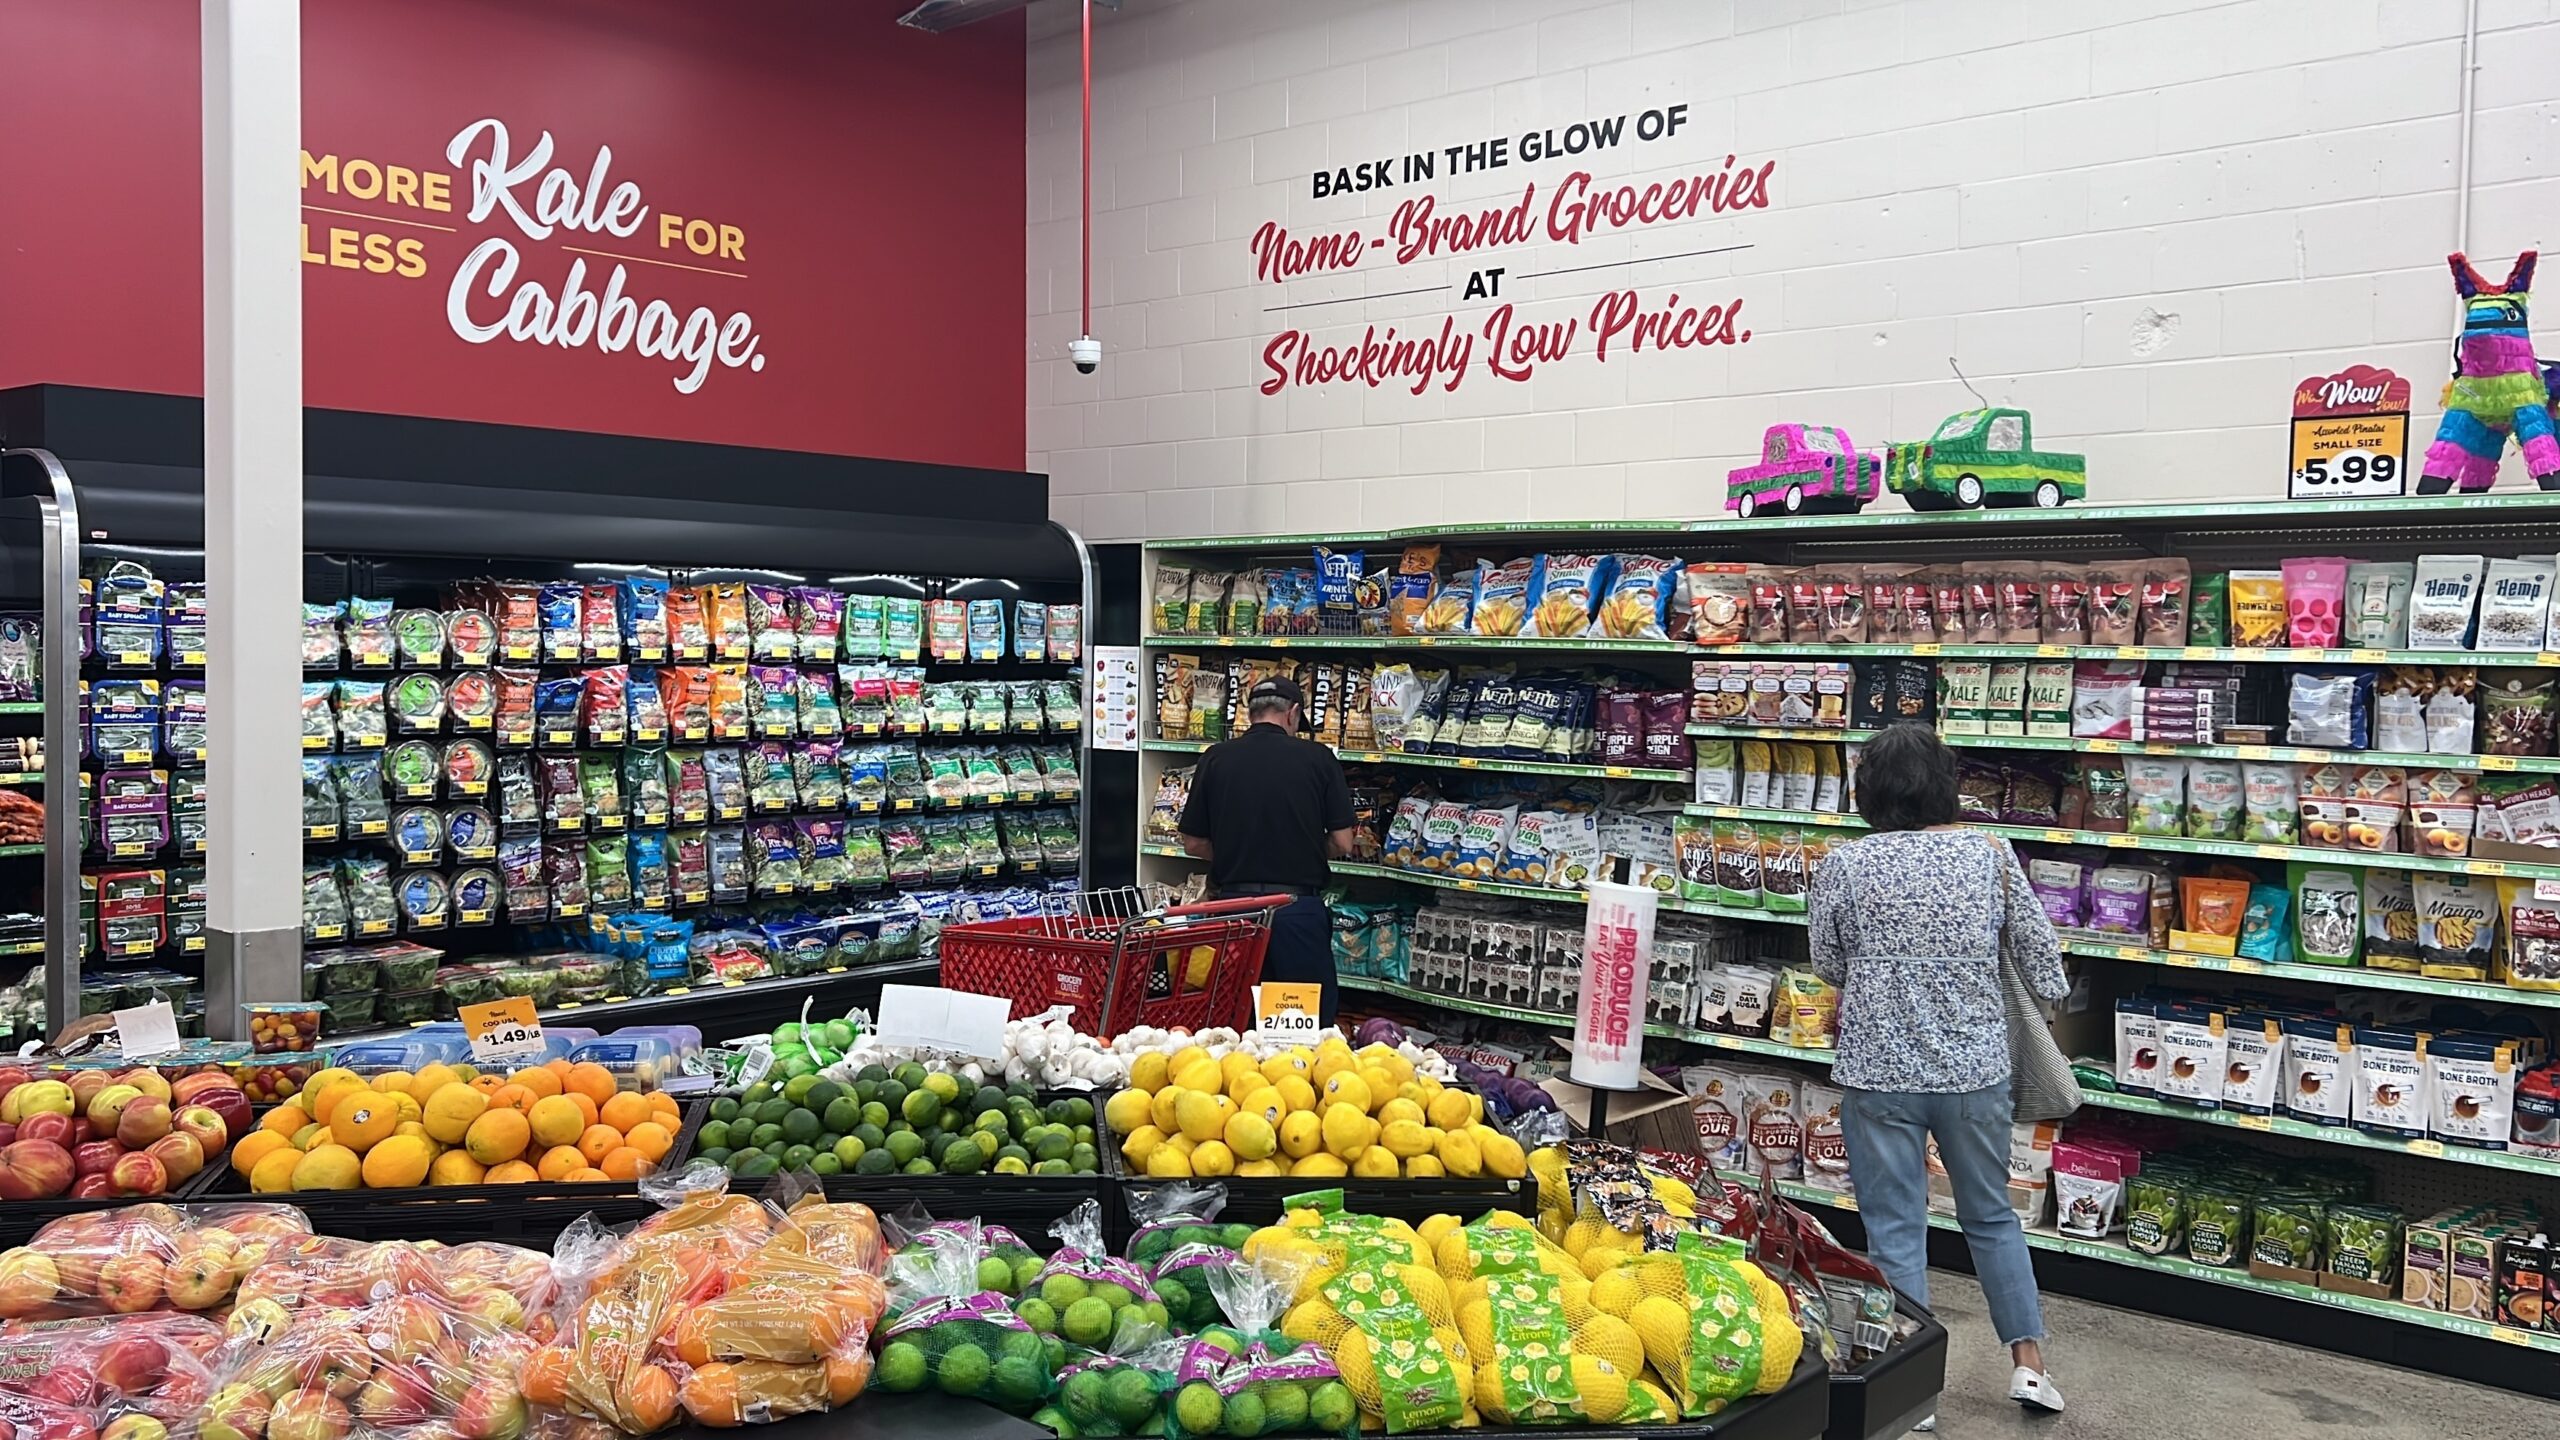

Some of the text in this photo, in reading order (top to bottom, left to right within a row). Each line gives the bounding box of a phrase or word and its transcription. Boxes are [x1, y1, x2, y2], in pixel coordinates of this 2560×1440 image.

[1312, 104, 1688, 200] BASK IN THE GLOW OF
[301, 118, 745, 261] MORE Kale FOR
[1546, 154, 1776, 245] Groceries
[1463, 268, 1505, 301] AT
[301, 223, 765, 394] LESS Cabbage.
[1260, 289, 1752, 396] Shockingly Low Prices.
[2319, 379, 2390, 408] Wow!
[2312, 424, 2350, 437] Assorted
[2313, 439, 2382, 449] SMALL SIZE
[2296, 455, 2395, 485] $5.99
[2425, 578, 2469, 600] Hemp
[2496, 579, 2540, 600] Hemp
[765, 682, 779, 693] Kit
[1314, 667, 1331, 725] WILDE
[1950, 687, 1980, 701] KALE
[1990, 687, 2017, 701] KALE
[2032, 687, 2064, 703] KALE
[1647, 735, 1679, 745] PURPLE
[766, 754, 780, 763] Kit
[1502, 764, 1524, 772] NOSH
[2529, 788, 2551, 798] HEART
[2426, 900, 2484, 926] Mango
[1515, 929, 1532, 939] NORI
[657, 952, 678, 962] KALE
[1472, 961, 1488, 972] NORI
[1491, 966, 1508, 975] NORI
[1057, 974, 1082, 985] GROCERY
[1511, 970, 1528, 980] NORI
[1544, 971, 1561, 981] NORI
[1061, 983, 1078, 992] OUTLET
[1589, 925, 1612, 1043] EAT Your VEGGIES
[1605, 927, 1638, 1047] PRODUCE
[1664, 988, 1682, 998] NORI
[2451, 988, 2488, 997] NOSH
[1736, 1002, 1761, 1010] SUGAR
[1264, 1016, 1313, 1030] 2/$1.00
[2126, 1027, 2146, 1036] BONE
[2164, 1036, 2213, 1049] BONE BROTH
[2243, 1042, 2267, 1055] BROTH
[2292, 1050, 2339, 1064] BONE BROTH
[1531, 1063, 1553, 1075] JULY
[2363, 1060, 2420, 1076] BONE BROTH
[2439, 1072, 2498, 1086] BONE BROTH
[2534, 1102, 2554, 1113] BROTH
[2193, 1112, 2226, 1121] NOSH
[1753, 1134, 1798, 1146] FLOUR
[2316, 1130, 2350, 1140] NOSH
[2450, 1151, 2487, 1161] NOSH
[2135, 1220, 2157, 1229] GREEN
[2192, 1236, 2222, 1246] BANANA
[2196, 1231, 2219, 1239] GREEN
[2075, 1246, 2105, 1257] NOSH
[2195, 1242, 2218, 1251] FLOUR
[2260, 1244, 2287, 1254] GREEN
[2339, 1254, 2365, 1265] GREEN
[2506, 1253, 2539, 1268] Imagine
[2335, 1260, 2368, 1273] BANANA
[2336, 1266, 2363, 1278] FLOUR
[2189, 1268, 2221, 1280] NOSH
[2312, 1292, 2346, 1304] NOSH
[2443, 1321, 2480, 1333] NOSH
[1512, 1331, 1551, 1341] Citrons
[1402, 1404, 1445, 1419] Lemons
